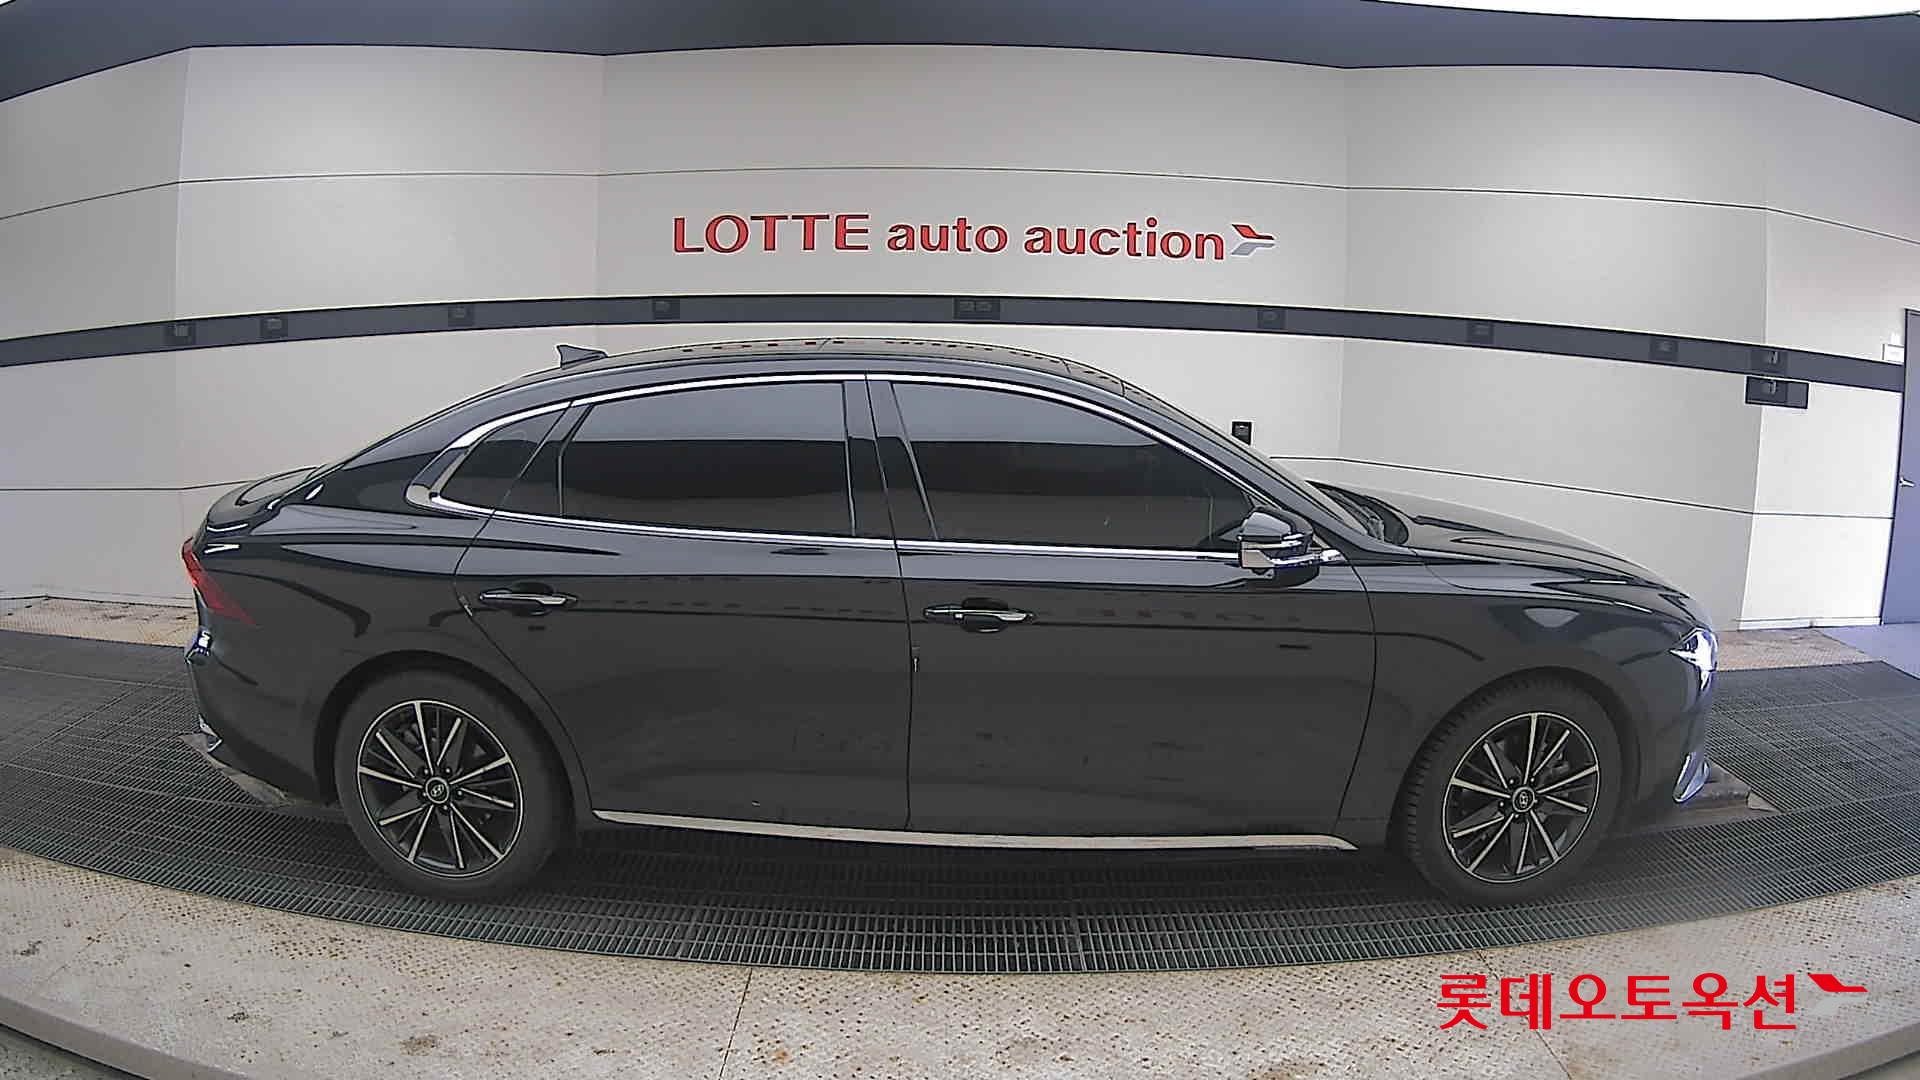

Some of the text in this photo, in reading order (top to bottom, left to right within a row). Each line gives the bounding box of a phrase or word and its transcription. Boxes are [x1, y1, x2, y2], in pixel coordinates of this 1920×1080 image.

[673, 214, 1225, 261] LOTTE auto auction
